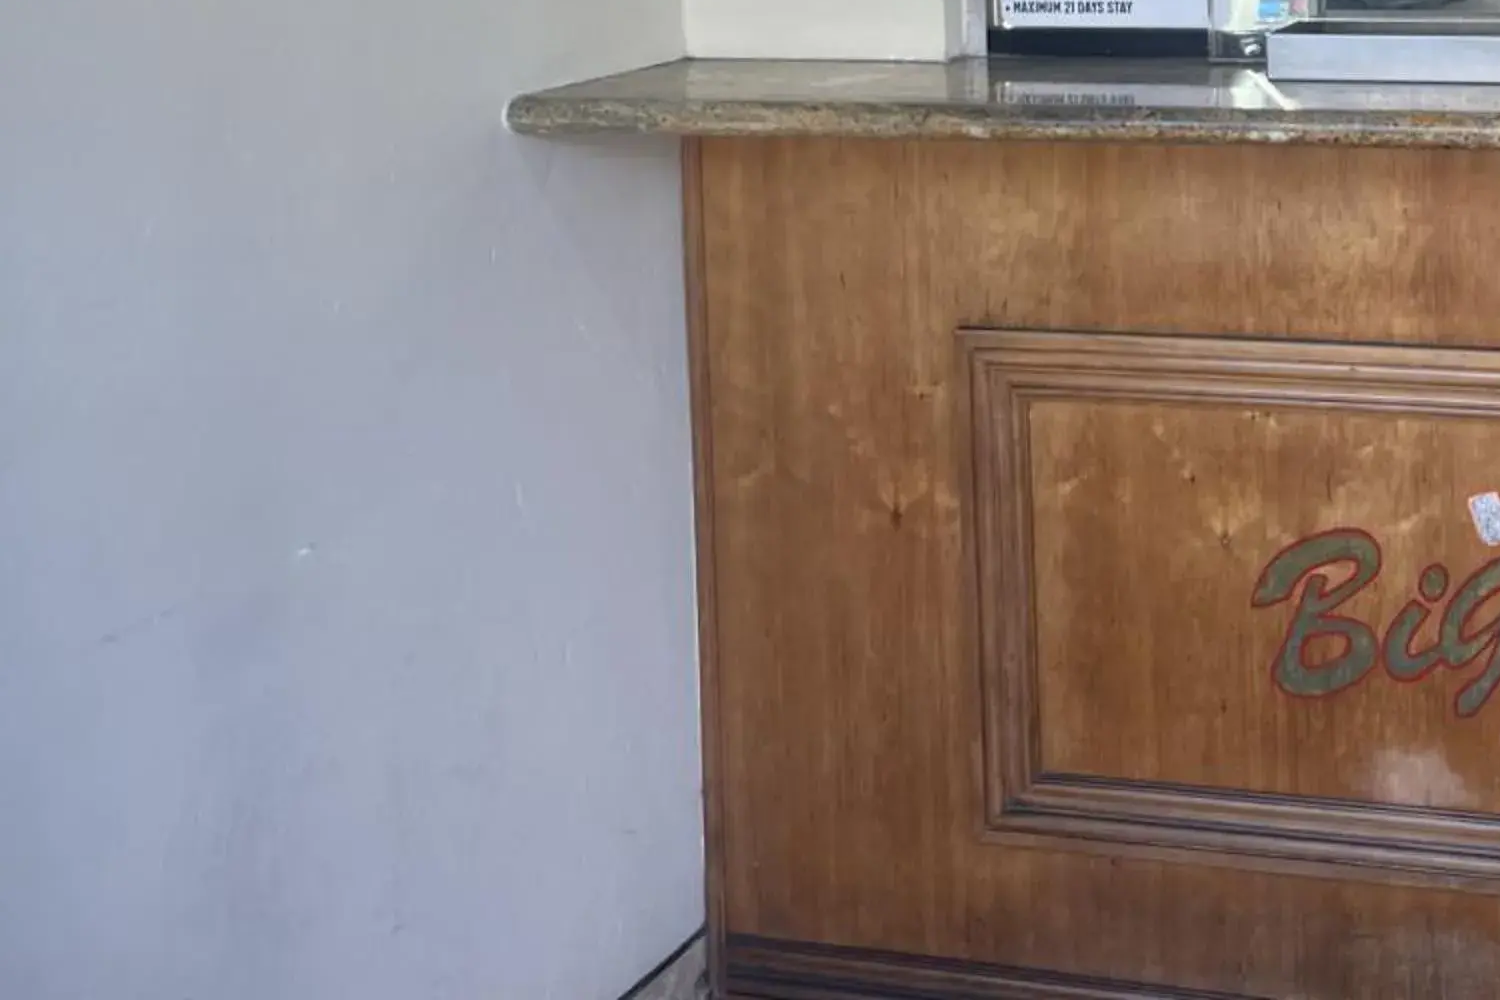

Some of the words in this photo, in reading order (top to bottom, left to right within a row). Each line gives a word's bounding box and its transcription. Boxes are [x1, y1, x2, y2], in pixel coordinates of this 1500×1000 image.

[1013, 0, 1061, 14] MAXIMUM
[1063, 0, 1075, 14] 21
[1077, 0, 1105, 14] DAYS
[1107, 0, 1133, 14] STAY
